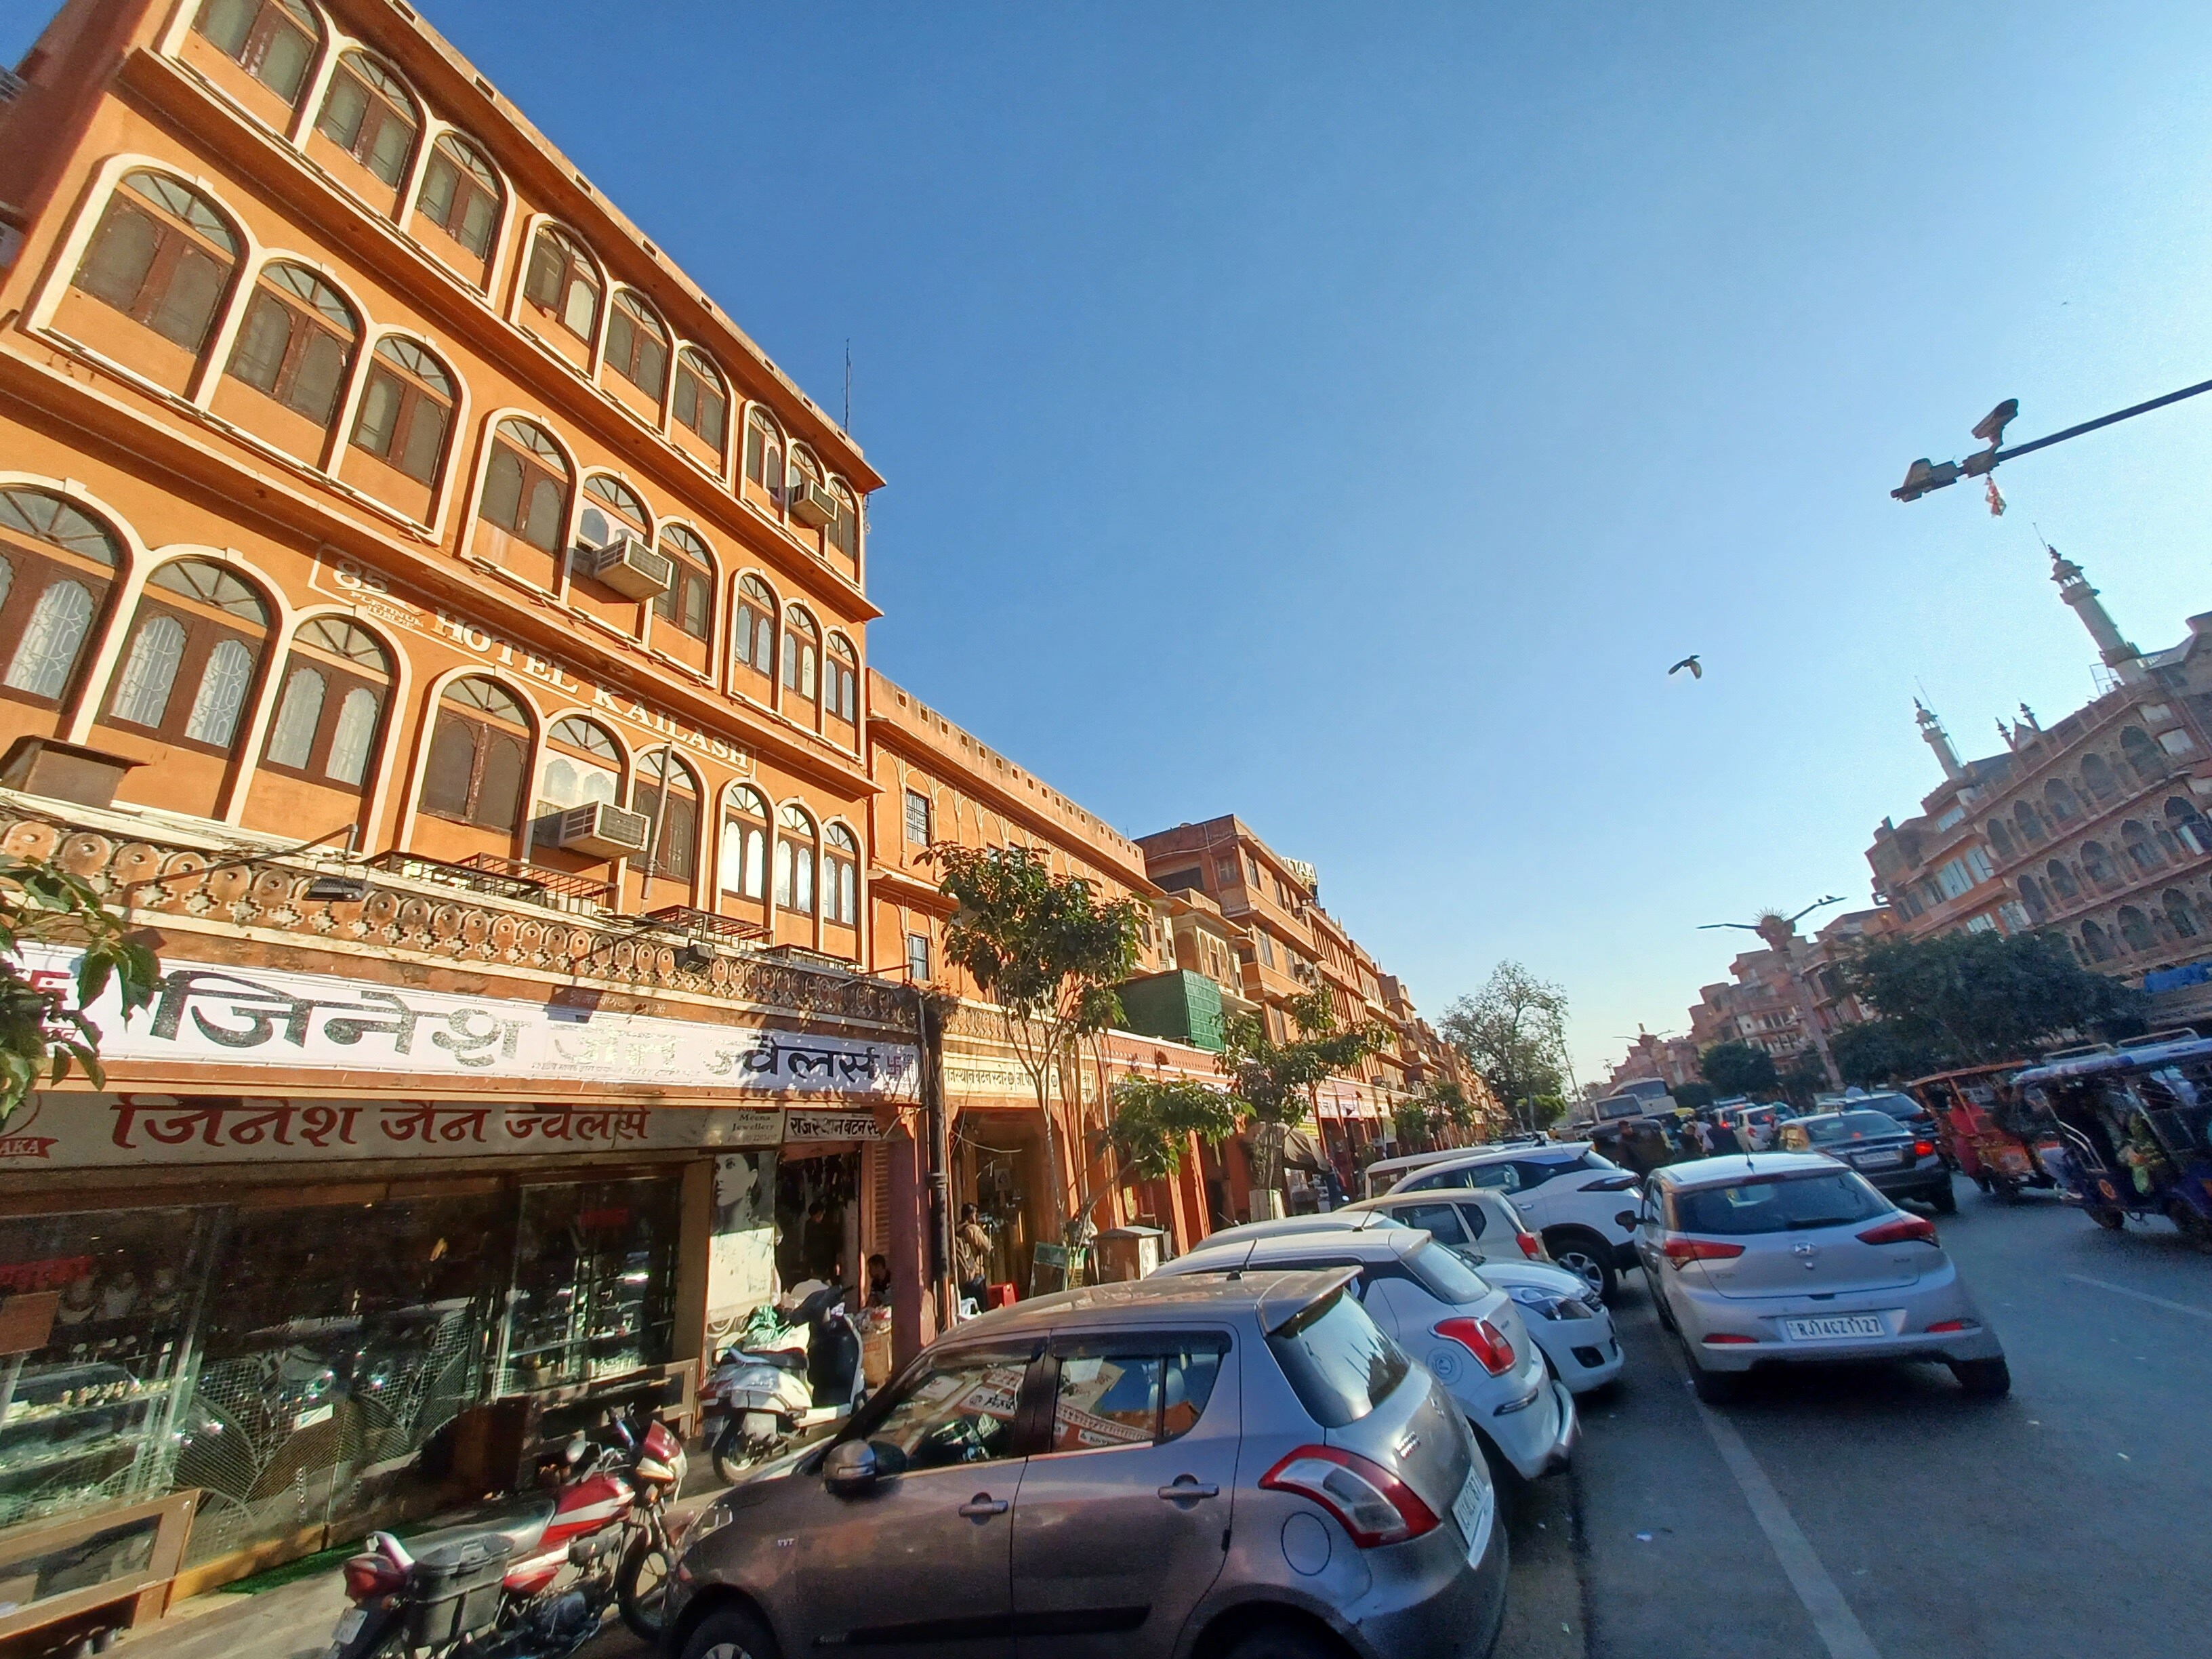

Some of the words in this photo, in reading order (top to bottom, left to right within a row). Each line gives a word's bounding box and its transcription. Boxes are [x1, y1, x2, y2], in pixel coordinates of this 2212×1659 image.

[333, 559, 388, 594] 85
[430, 607, 579, 695] HOTEL
[591, 680, 749, 769] KAILASH
[150, 970, 532, 1068] जिनेश
[943, 1067, 975, 1085] राजस्थान
[991, 1064, 1008, 1086] स्टोर
[109, 1093, 363, 1149] जिनेश
[380, 1099, 493, 1144] जैन
[732, 1122, 775, 1132] Jewellery
[739, 1113, 771, 1122] Meena
[790, 1117, 845, 1136] राजस्थान
[844, 1118, 868, 1136] बटन
[1797, 1318, 1880, 1336] RJ14CZ1127
